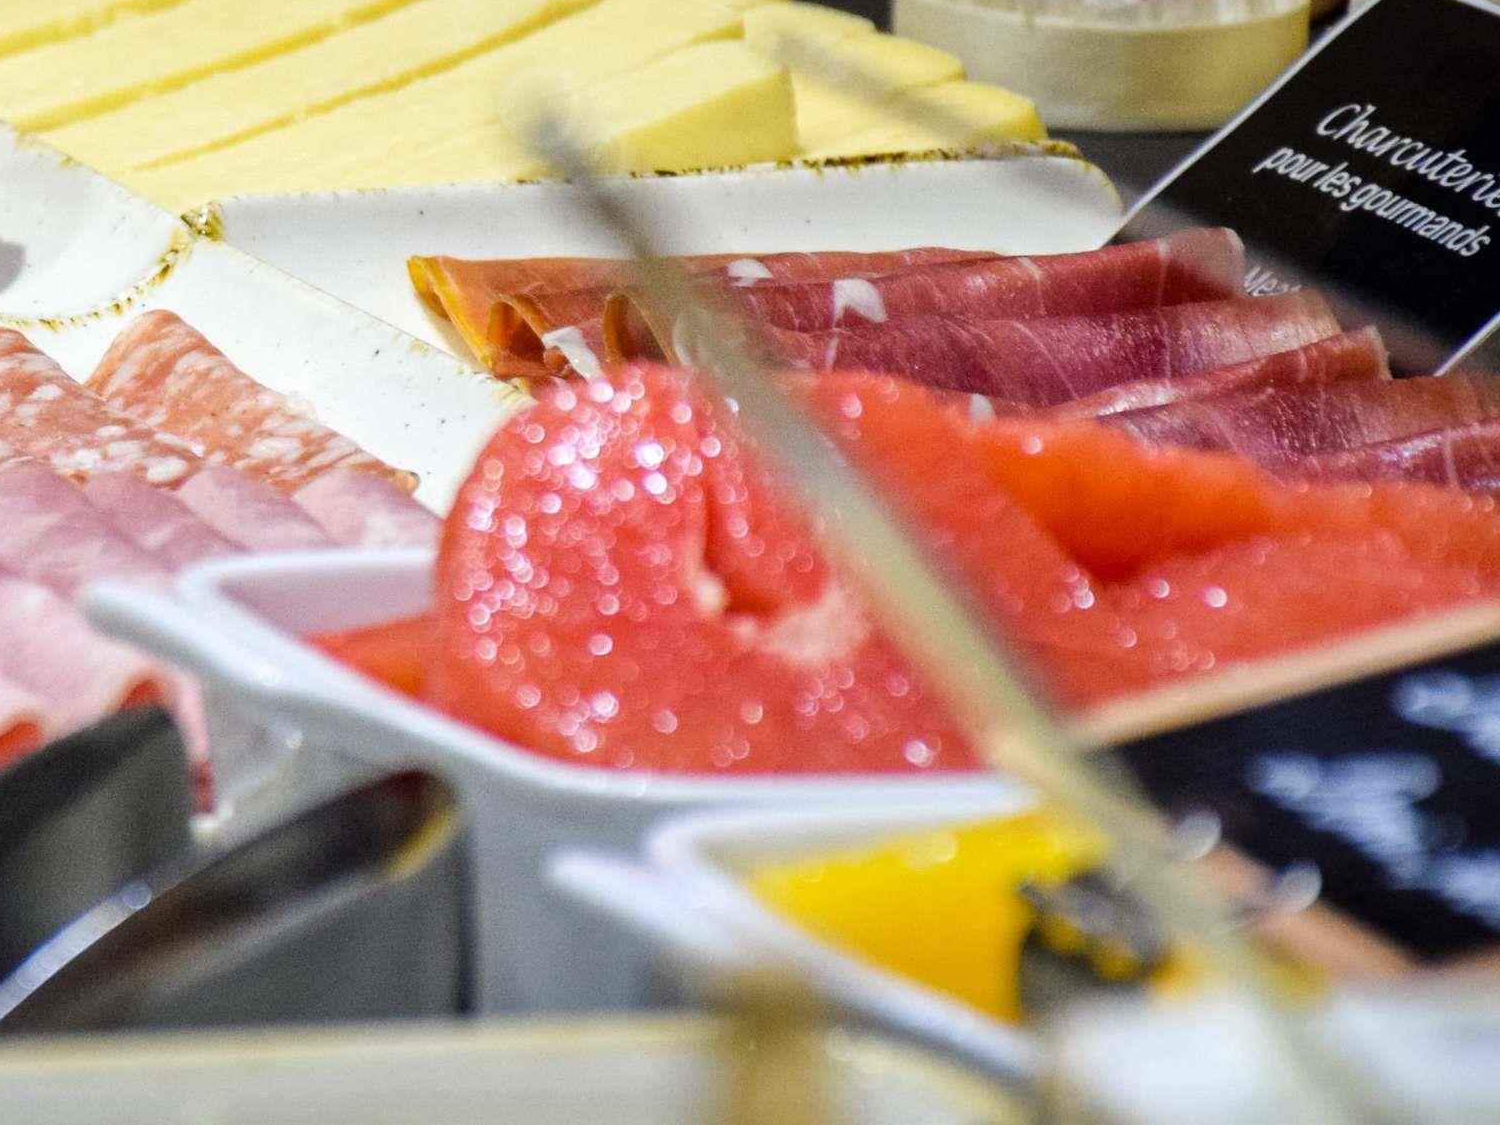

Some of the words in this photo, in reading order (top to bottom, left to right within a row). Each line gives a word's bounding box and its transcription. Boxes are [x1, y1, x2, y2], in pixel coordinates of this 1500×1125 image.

[1252, 146, 1332, 186] pour
[1319, 162, 1362, 199] les
[1340, 182, 1492, 257] gourmands
